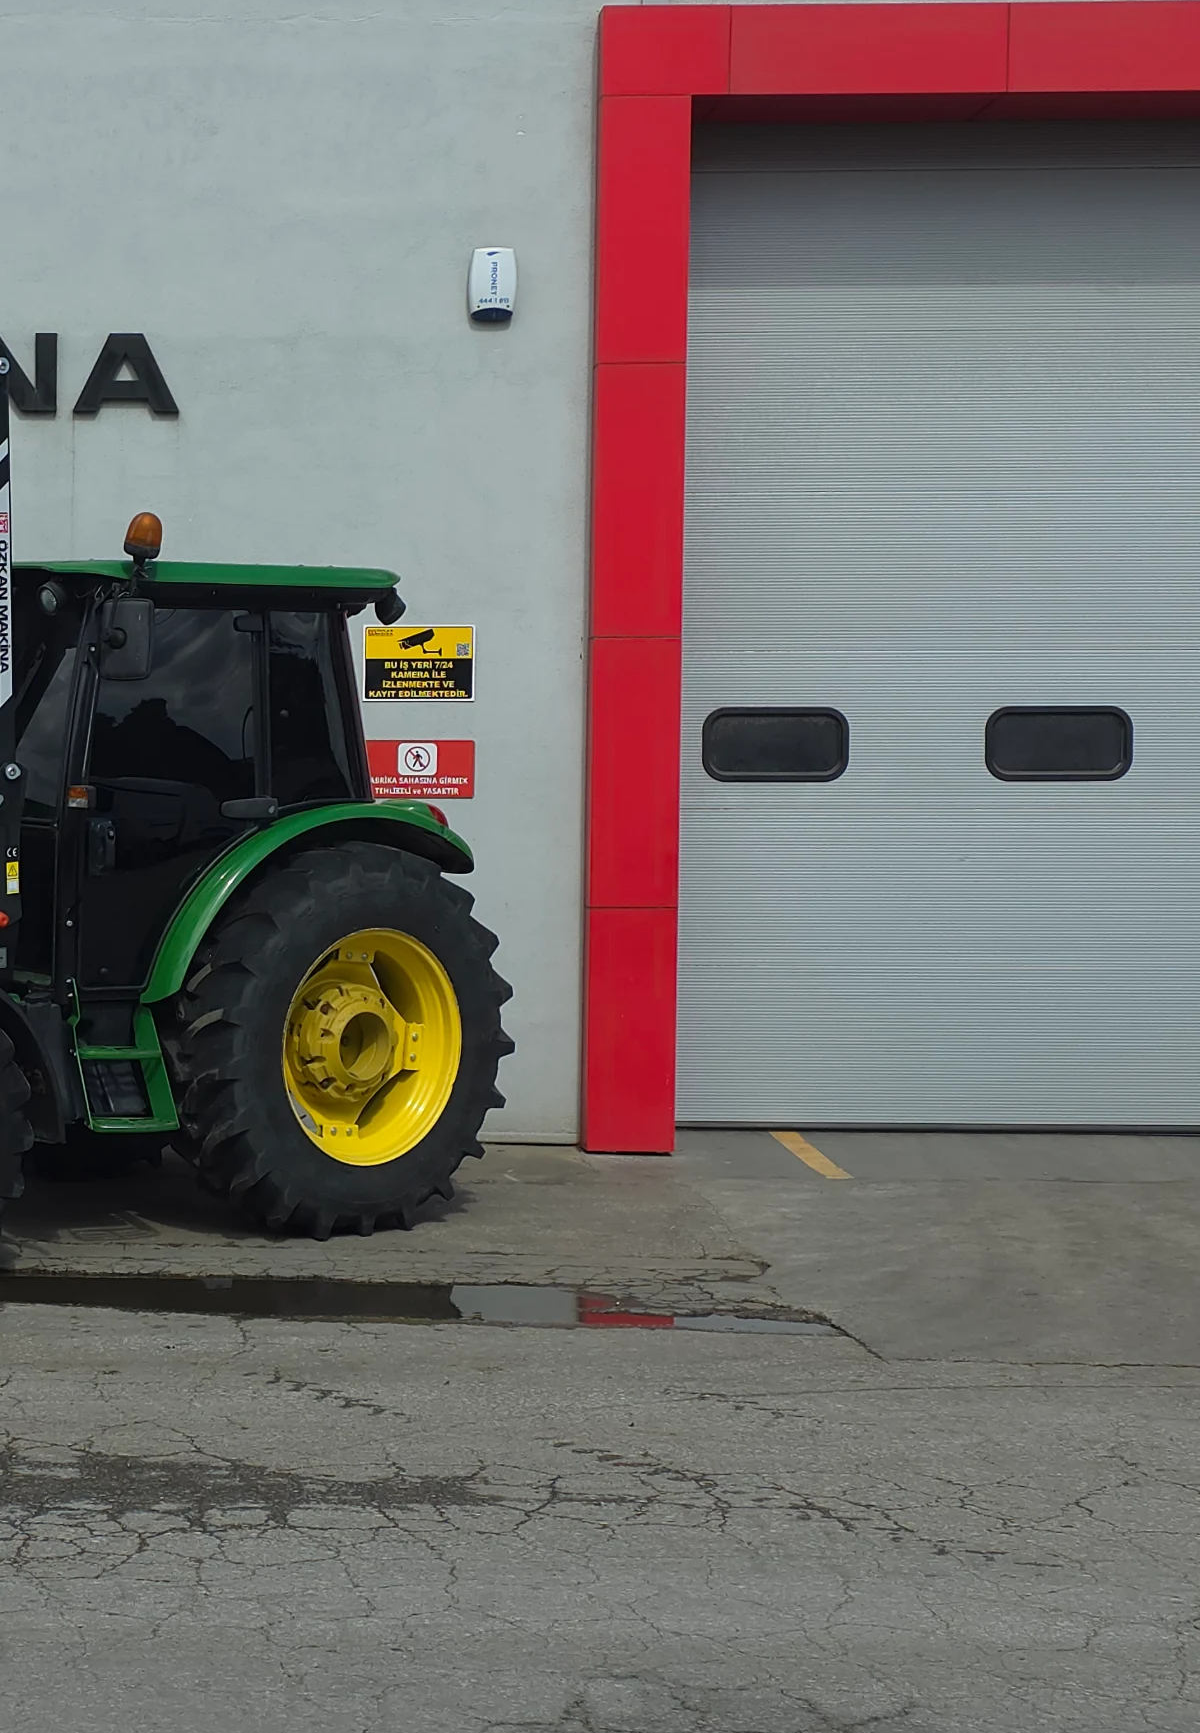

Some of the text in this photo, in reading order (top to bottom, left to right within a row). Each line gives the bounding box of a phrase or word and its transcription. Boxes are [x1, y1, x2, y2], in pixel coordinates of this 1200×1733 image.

[490, 261, 498, 296] PRONET
[0, 605, 10, 674] MAKİNA
[384, 660, 453, 670] BU İŞ YERİ 7/24
[432, 670, 447, 678] İLE
[383, 680, 455, 688] İZLENMEKTE VE
[369, 690, 397, 698] KAYIT
[399, 776, 438, 784] SAHASINA
[439, 775, 468, 784] GİRMEK
[422, 787, 459, 795] YASAKTIR
